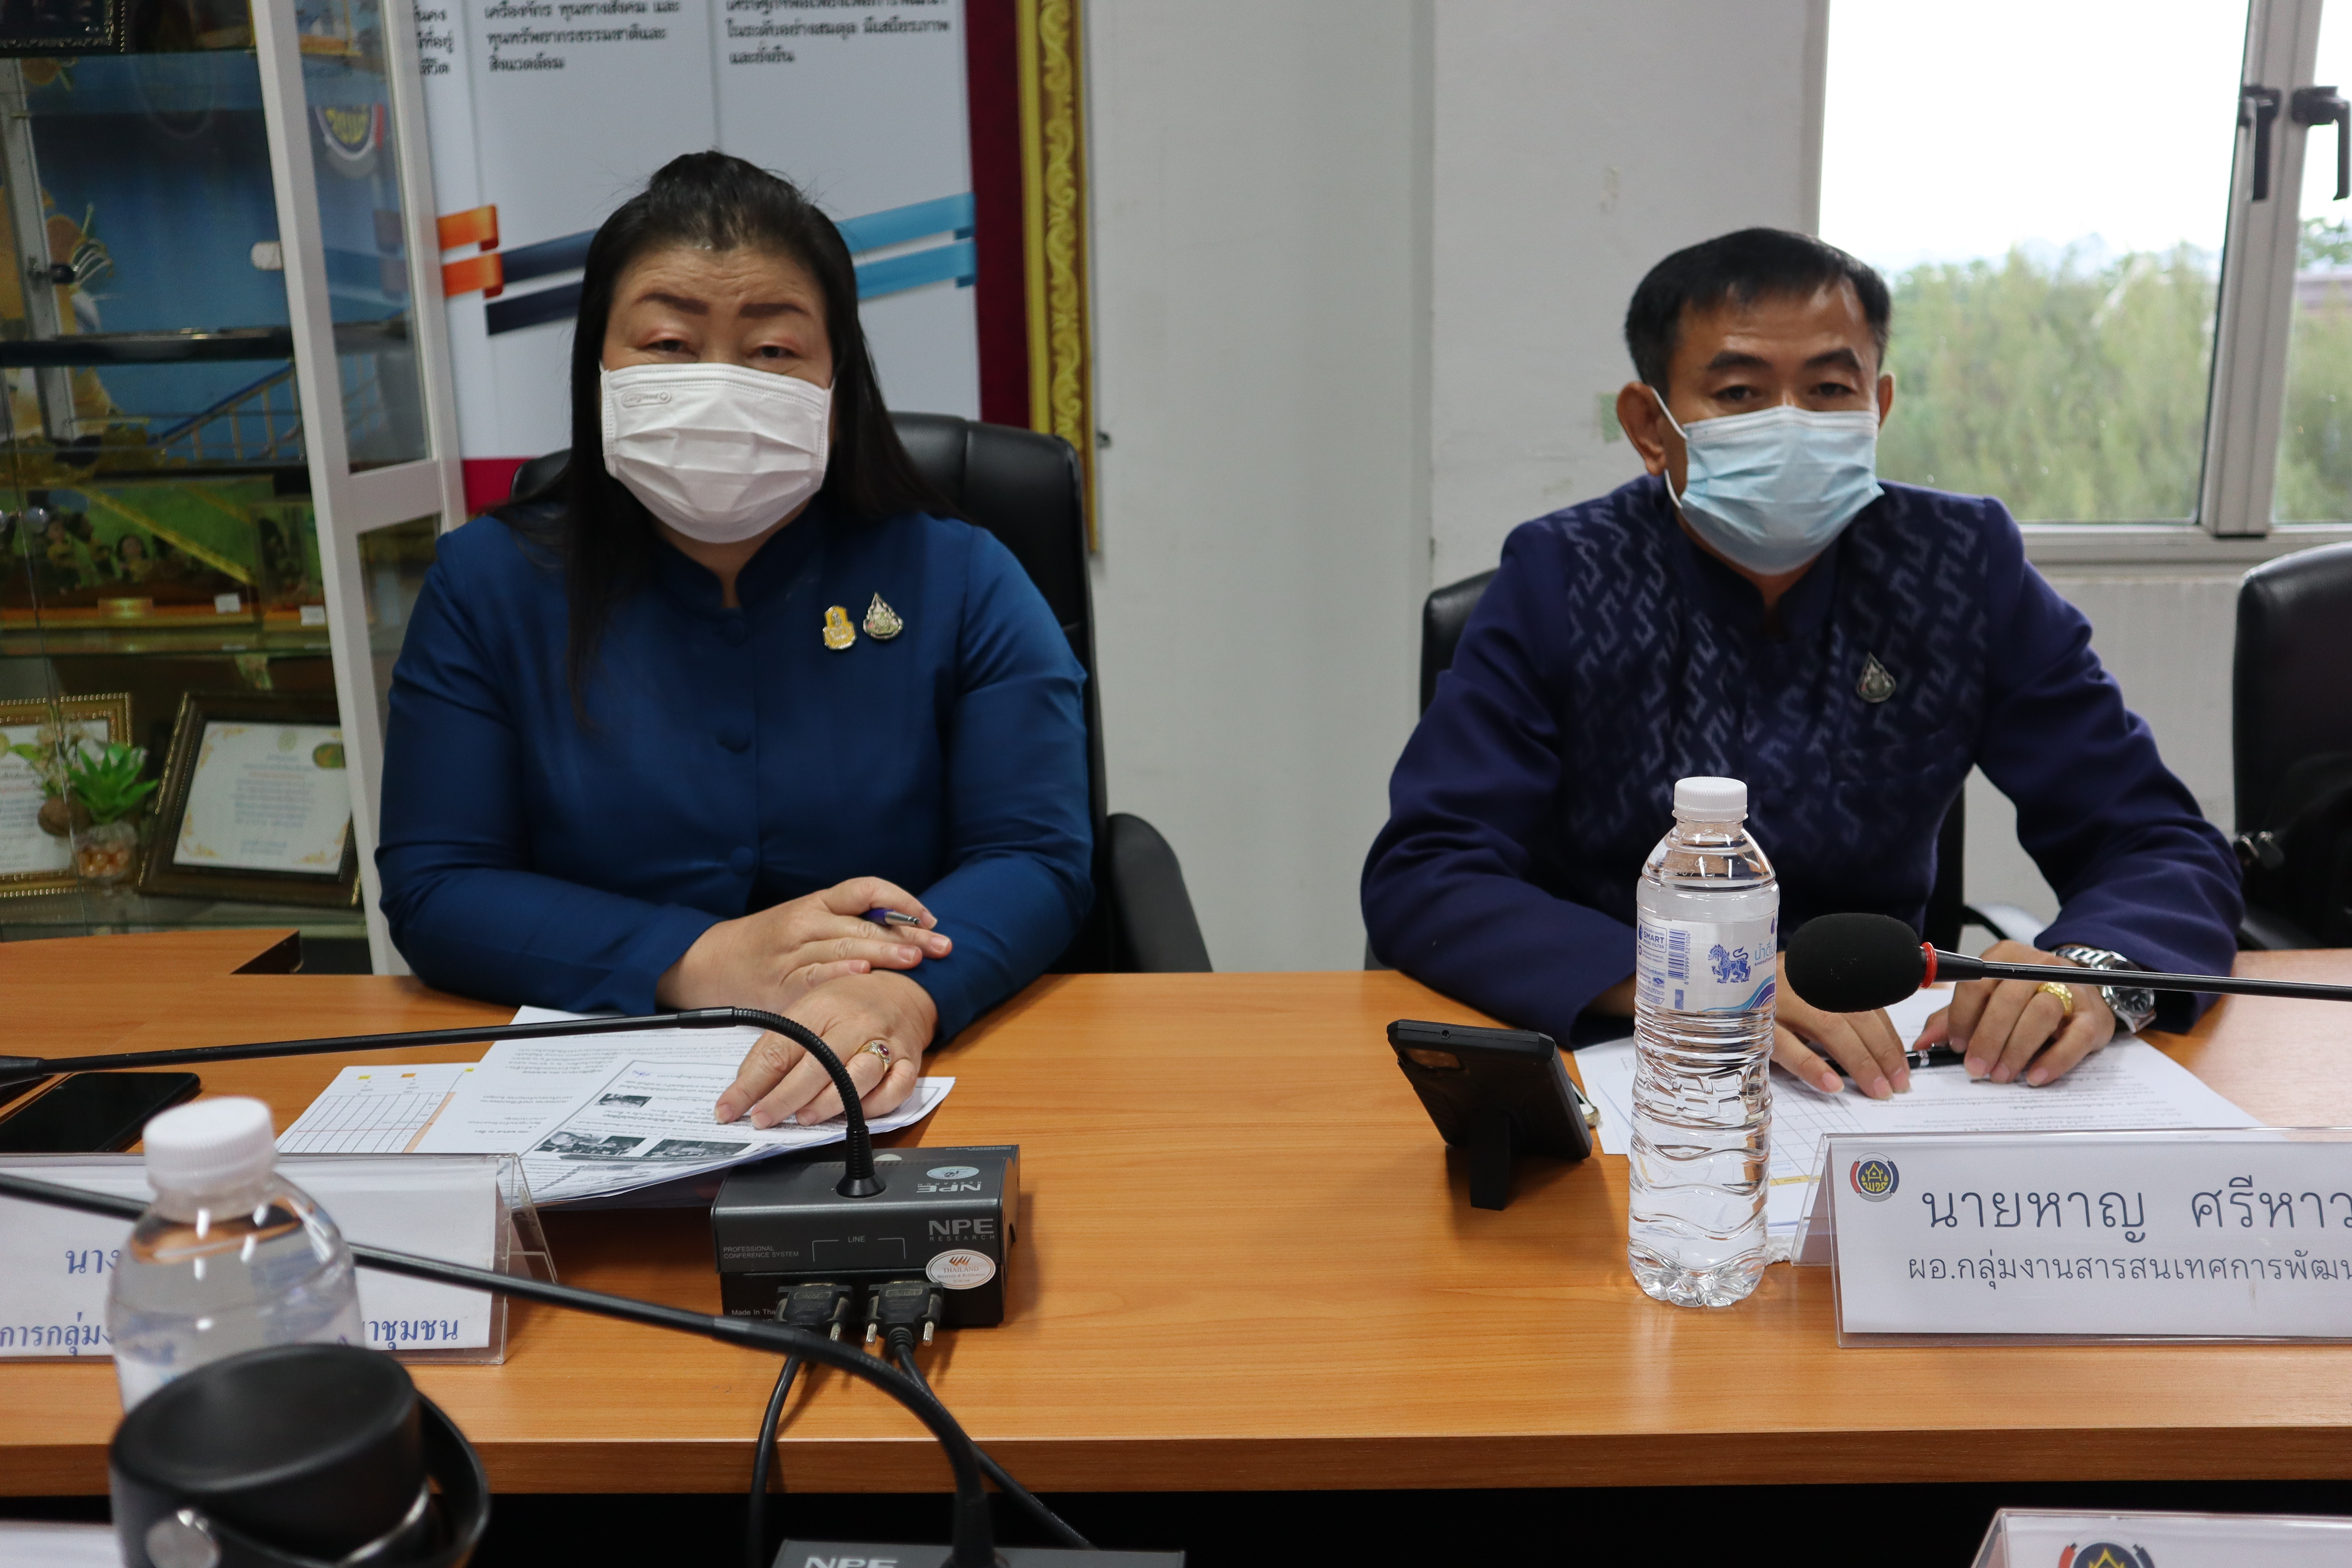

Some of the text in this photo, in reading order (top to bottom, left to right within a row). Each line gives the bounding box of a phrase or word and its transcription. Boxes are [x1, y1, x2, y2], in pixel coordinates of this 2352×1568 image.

[1644, 931, 1665, 944] SMART
[916, 1183, 981, 1193] NPE
[1922, 1192, 2146, 1243] นายหาญ
[929, 1218, 994, 1235] NPE
[363, 1319, 458, 1350] าชุมชน
